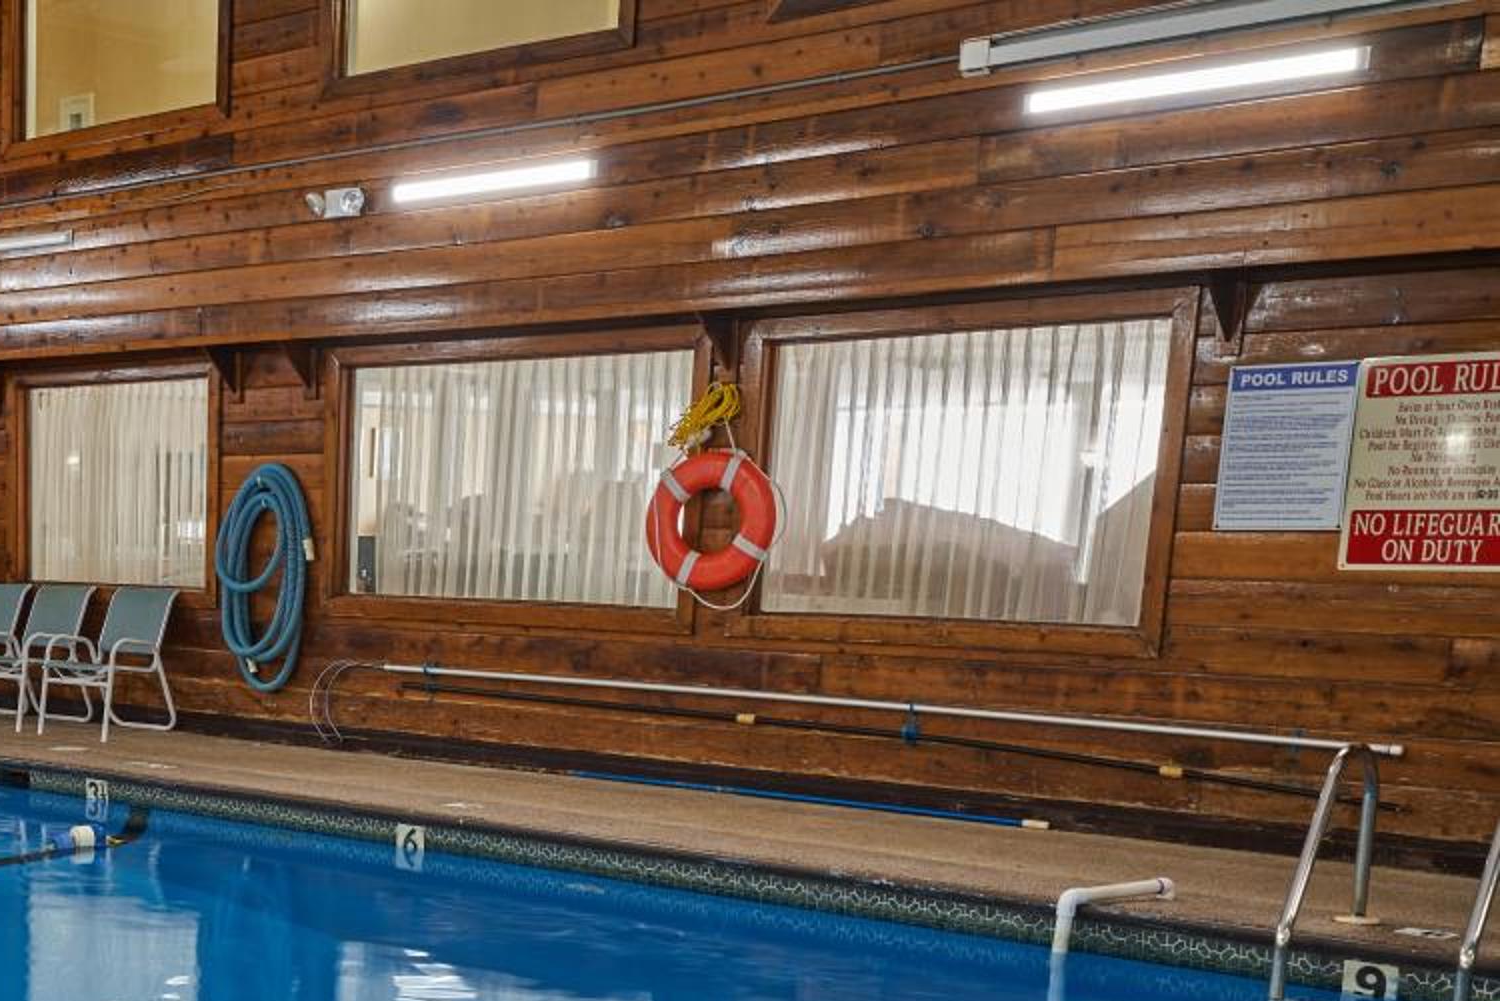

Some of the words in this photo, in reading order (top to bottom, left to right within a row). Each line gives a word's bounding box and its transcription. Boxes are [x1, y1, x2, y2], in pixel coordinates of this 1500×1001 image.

[1241, 373, 1286, 387] POOL
[1291, 370, 1349, 384] RULES
[1372, 365, 1443, 395] POOL
[1354, 512, 1386, 536] NO
[1381, 539, 1414, 563] ON
[1420, 539, 1483, 563] DUTY
[1355, 965, 1387, 998] 9
